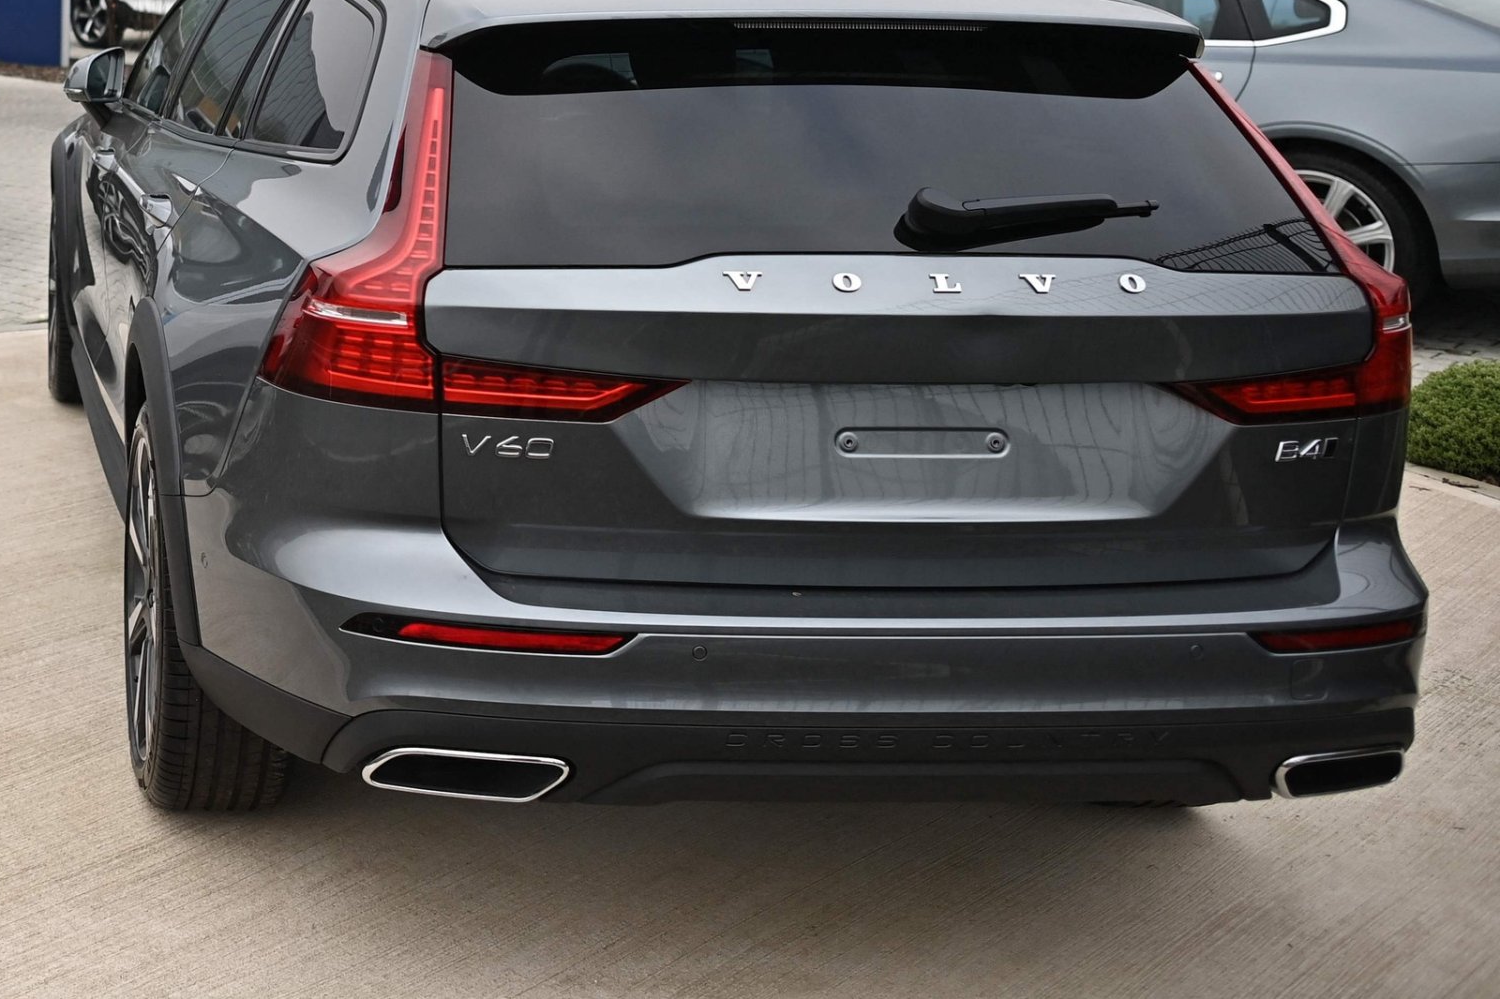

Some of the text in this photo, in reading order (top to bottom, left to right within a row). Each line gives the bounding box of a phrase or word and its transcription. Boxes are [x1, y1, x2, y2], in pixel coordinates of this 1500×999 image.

[723, 270, 1146, 294] VOLVO
[462, 433, 555, 459] V60
[724, 732, 900, 749] CROSS
